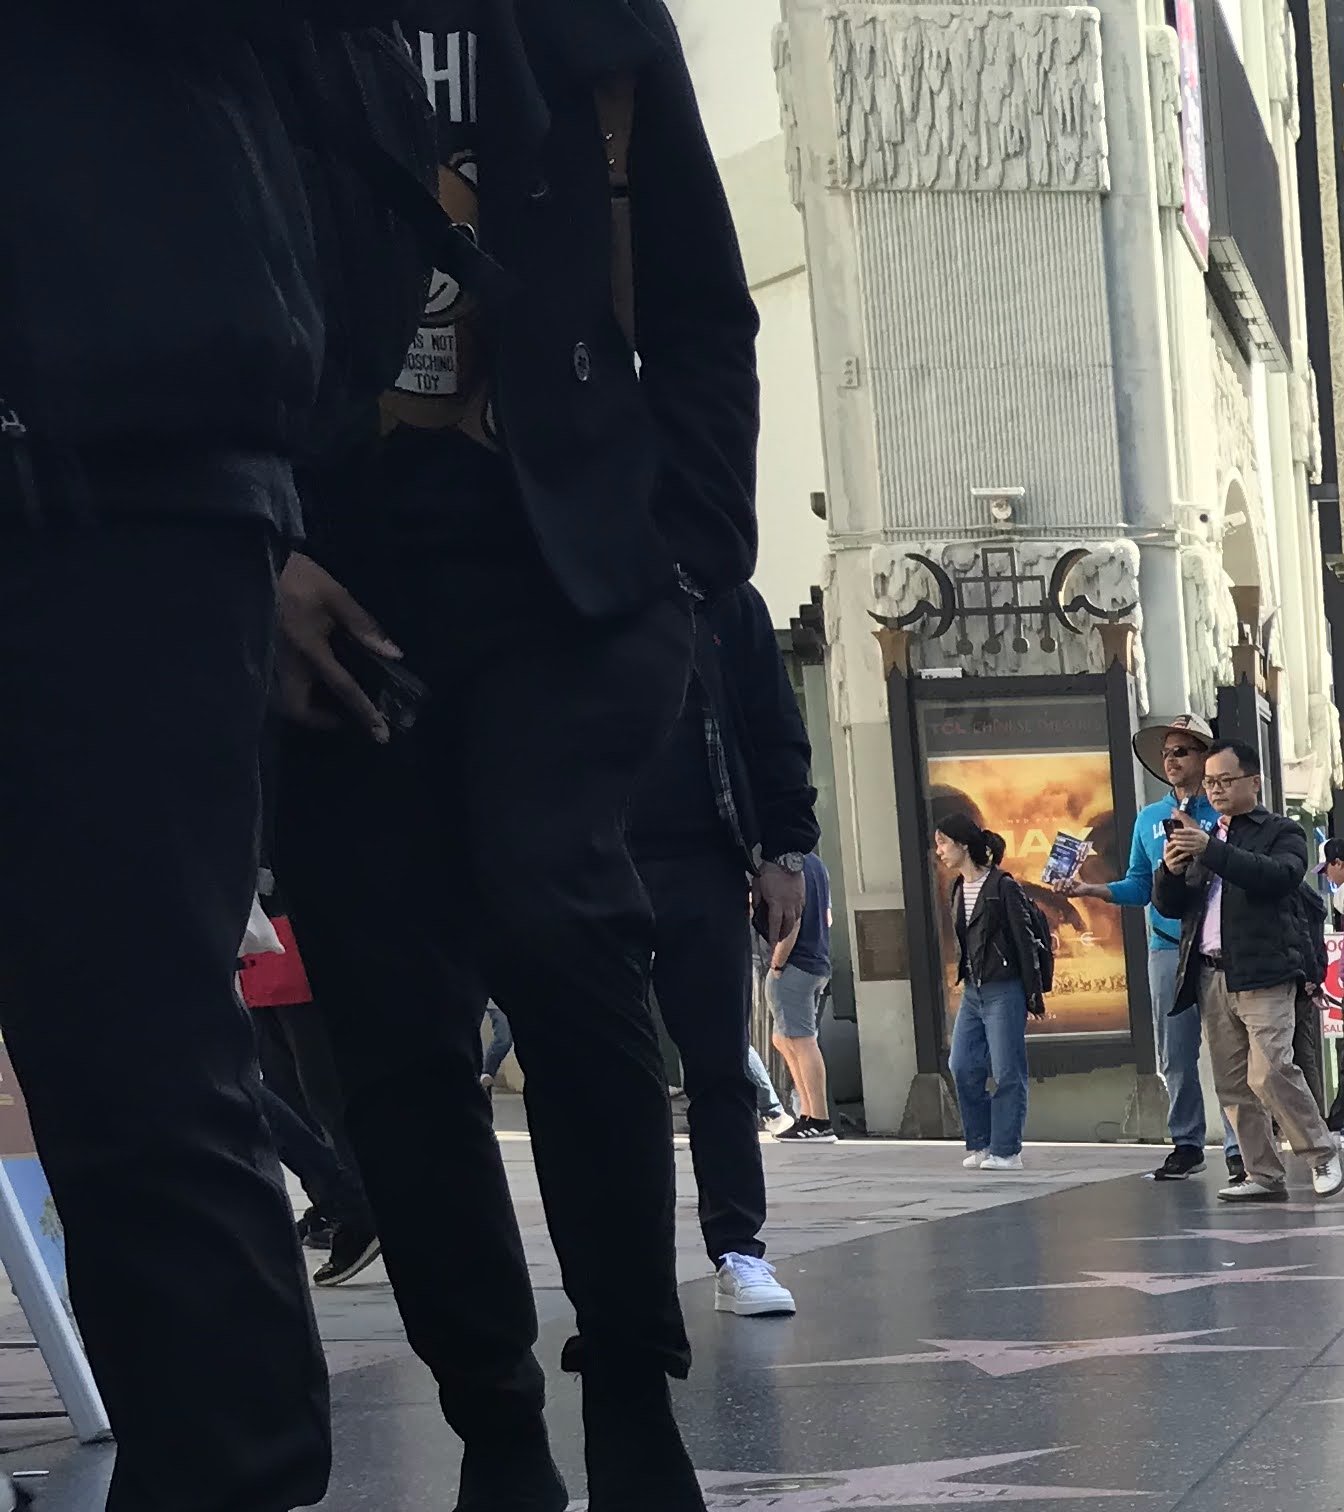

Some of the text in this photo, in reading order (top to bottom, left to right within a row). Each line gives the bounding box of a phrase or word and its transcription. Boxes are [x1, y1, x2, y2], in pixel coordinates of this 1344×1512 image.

[431, 333, 454, 351] NOT
[407, 353, 455, 372] OSCHINO
[414, 373, 440, 391] TOY
